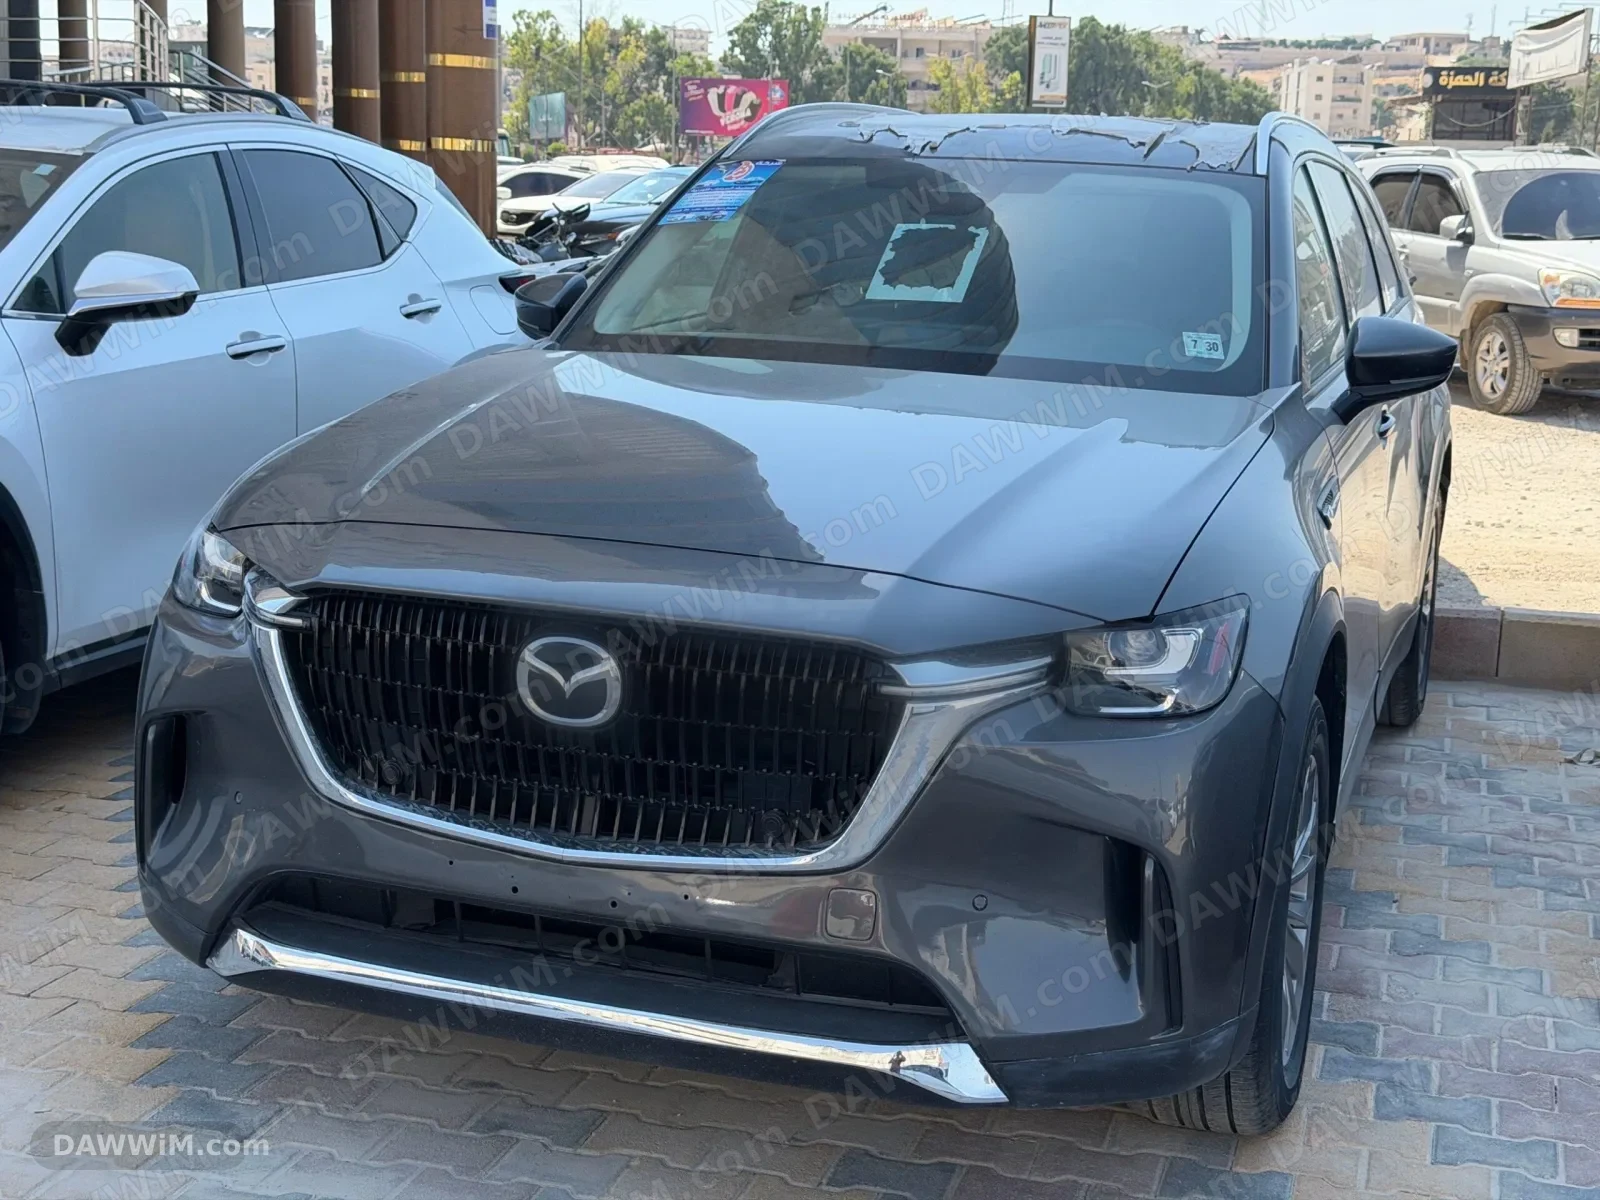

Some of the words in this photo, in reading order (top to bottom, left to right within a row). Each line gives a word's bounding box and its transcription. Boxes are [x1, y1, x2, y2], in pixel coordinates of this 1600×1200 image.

[1438, 70, 1486, 89] الحمزة
[1488, 70, 1508, 87] كة
[1190, 339, 1198, 349] 7
[1205, 341, 1219, 352] 30
